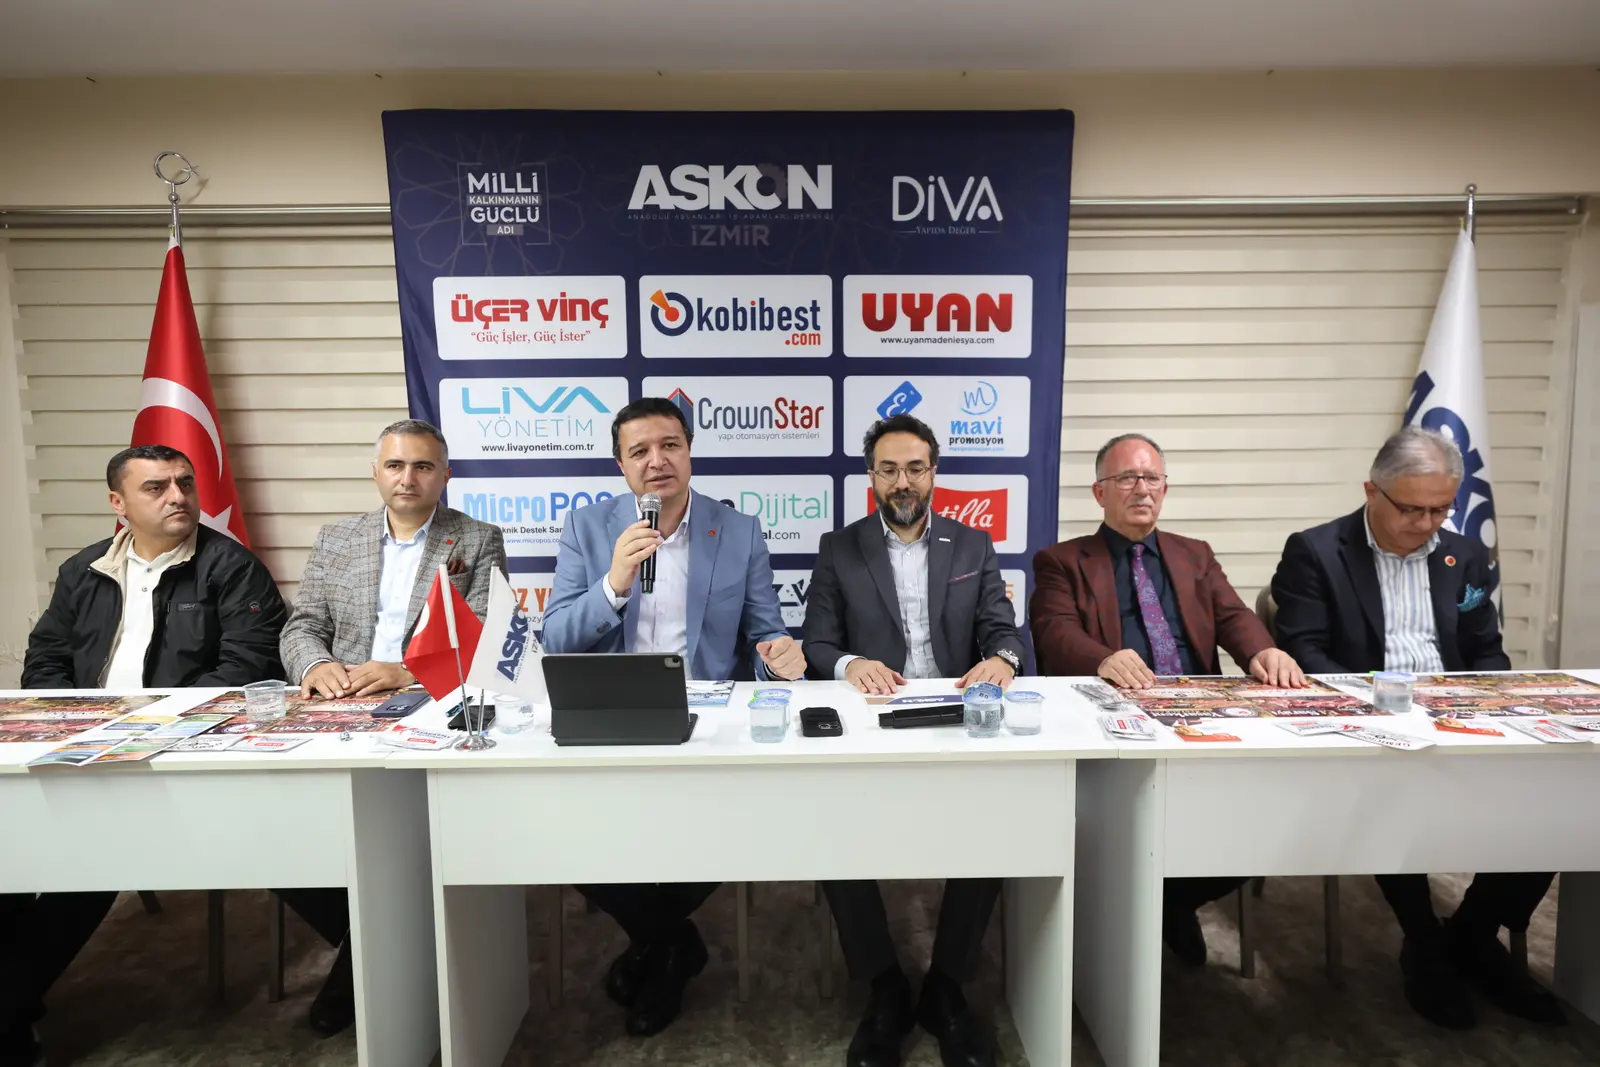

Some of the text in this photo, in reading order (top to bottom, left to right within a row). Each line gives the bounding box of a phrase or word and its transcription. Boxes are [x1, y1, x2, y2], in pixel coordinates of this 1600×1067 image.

[627, 164, 832, 211] ASKON
[469, 195, 539, 205] KALKINMANIN
[497, 225, 514, 234] ADI
[697, 297, 821, 331] kobibest
[861, 292, 1013, 333] UYAN
[533, 331, 557, 344] Güç
[785, 333, 821, 346] .com
[880, 335, 995, 345] www.uyanmadeniesya.com
[698, 397, 824, 430] CrownStar
[477, 416, 594, 439] YÖNETİM
[950, 416, 1003, 436] mavi
[736, 432, 780, 442] otomasyon
[781, 431, 820, 440] sistemleri
[949, 436, 1004, 446] promosyon
[481, 442, 594, 454] www.livayonetim.com.tr
[740, 490, 828, 527] Dijital
[501, 526, 518, 534] knik
[520, 526, 547, 534] Destek
